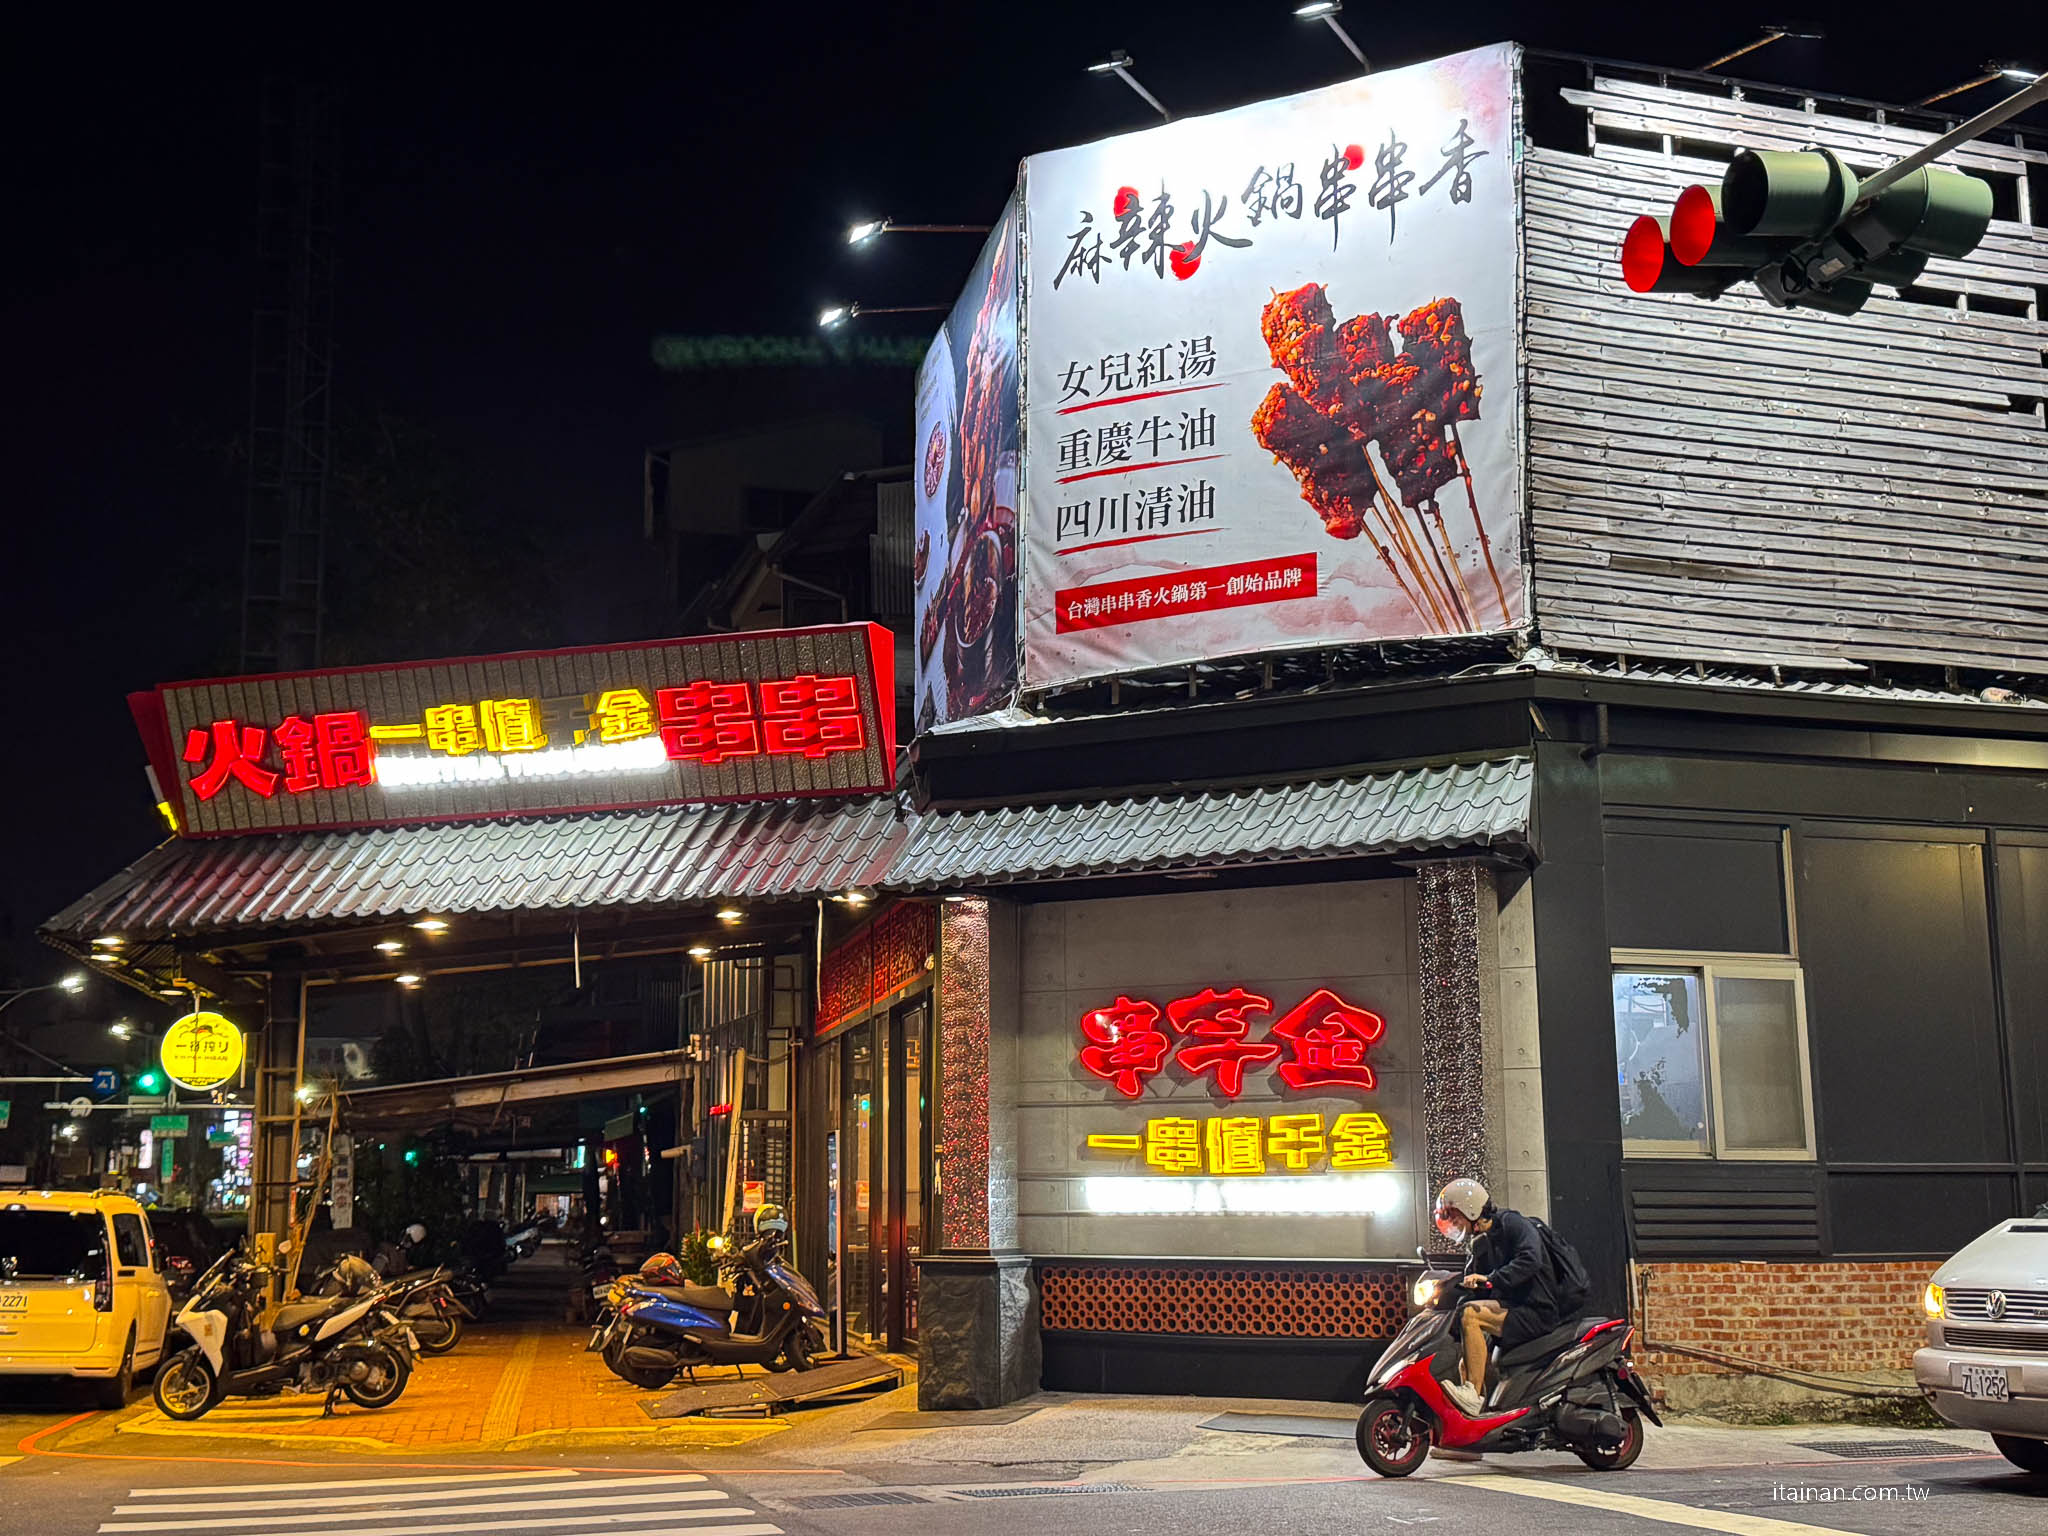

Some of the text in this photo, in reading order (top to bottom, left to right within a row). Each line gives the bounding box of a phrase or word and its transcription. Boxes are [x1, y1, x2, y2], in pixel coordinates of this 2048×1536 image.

[1053, 119, 1489, 290] 麻辣火鍋串串香
[1056, 335, 1217, 404] 女兒紅湯
[1056, 407, 1217, 473] 重慶牛油
[1056, 479, 1216, 542] 四川清油
[1068, 567, 1302, 620] 台灣串串香火鍋第一創始品牌
[1087, 1112, 1393, 1174] 一串值千金
